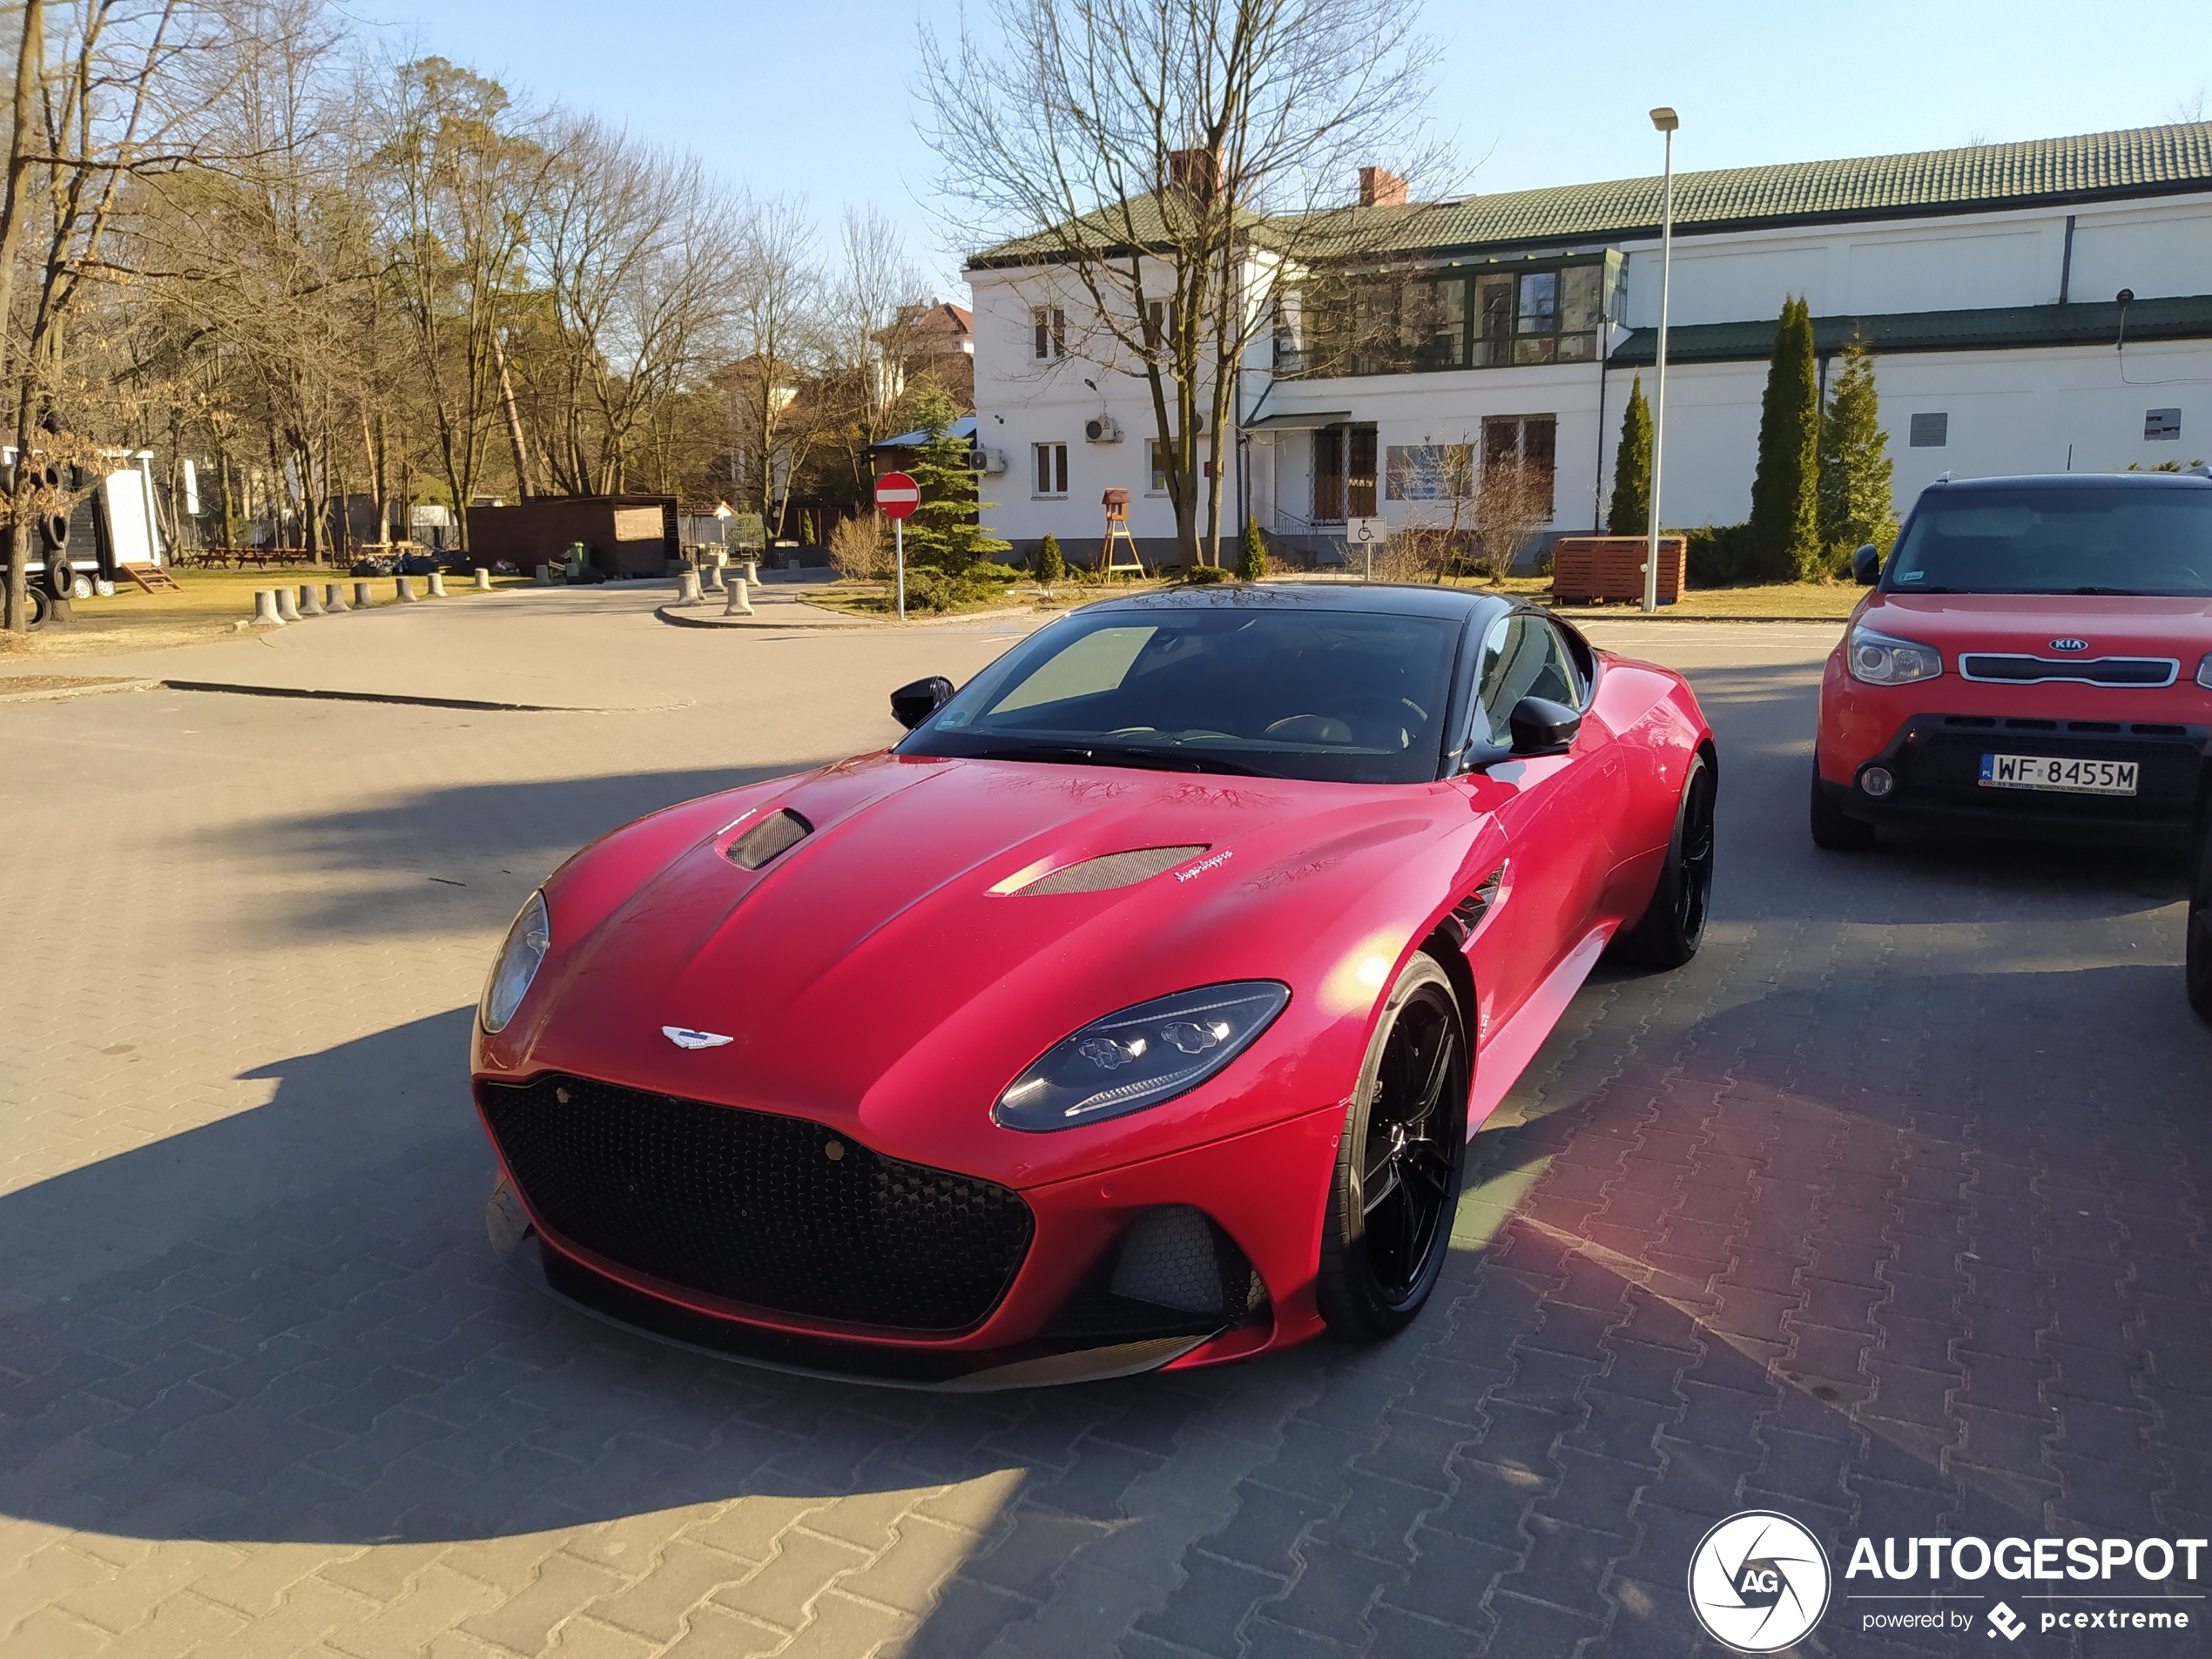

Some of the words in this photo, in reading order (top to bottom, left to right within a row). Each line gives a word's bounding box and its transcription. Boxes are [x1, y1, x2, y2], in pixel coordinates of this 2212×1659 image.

[2055, 640, 2081, 649] KIA
[1998, 757, 2037, 781] WF
[2047, 761, 2134, 788] 8455M
